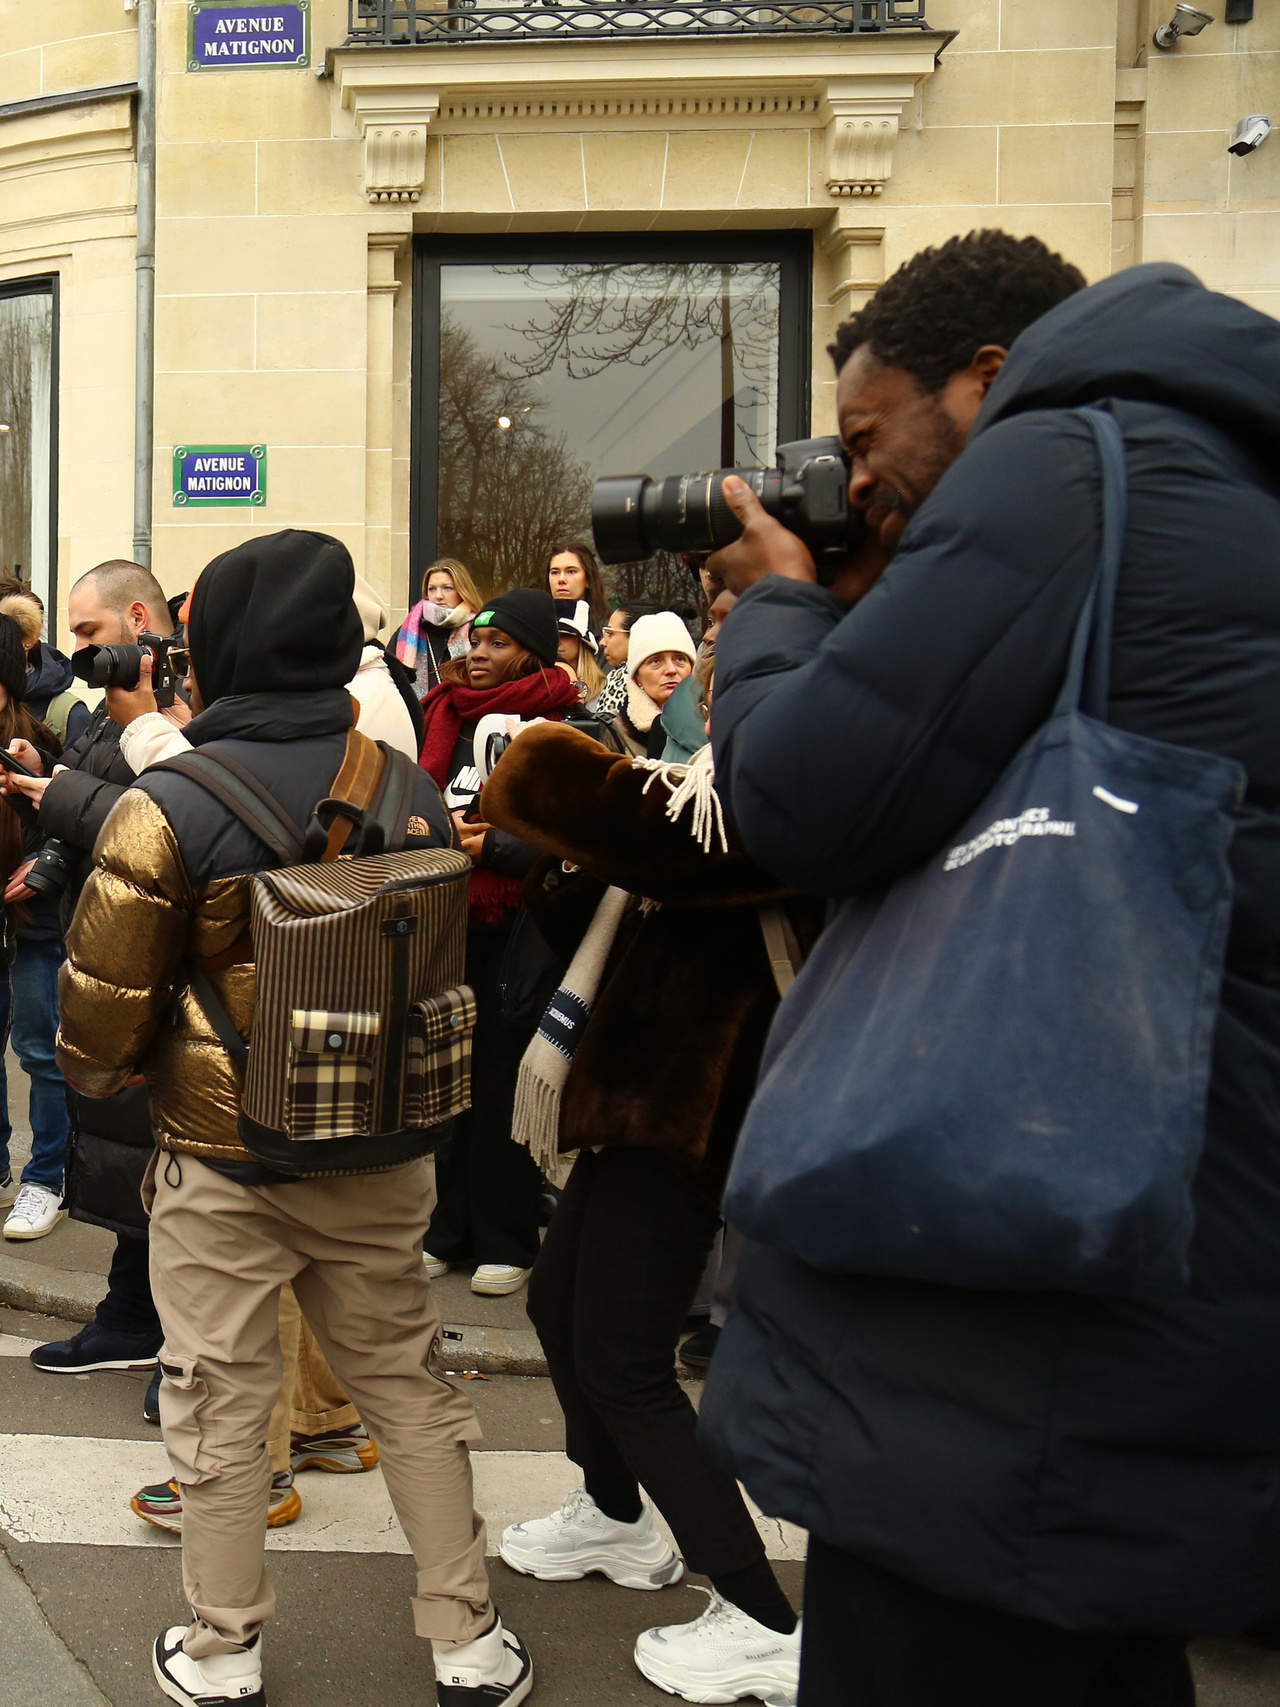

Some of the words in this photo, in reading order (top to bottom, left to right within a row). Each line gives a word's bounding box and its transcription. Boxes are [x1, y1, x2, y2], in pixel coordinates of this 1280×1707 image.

[215, 17, 284, 34] AVENUE
[204, 39, 295, 56] MATIGNON
[194, 457, 245, 472] AVENUE
[187, 477, 251, 491] MATIGNON
[745, 1647, 784, 1660] BALENCIAGA
